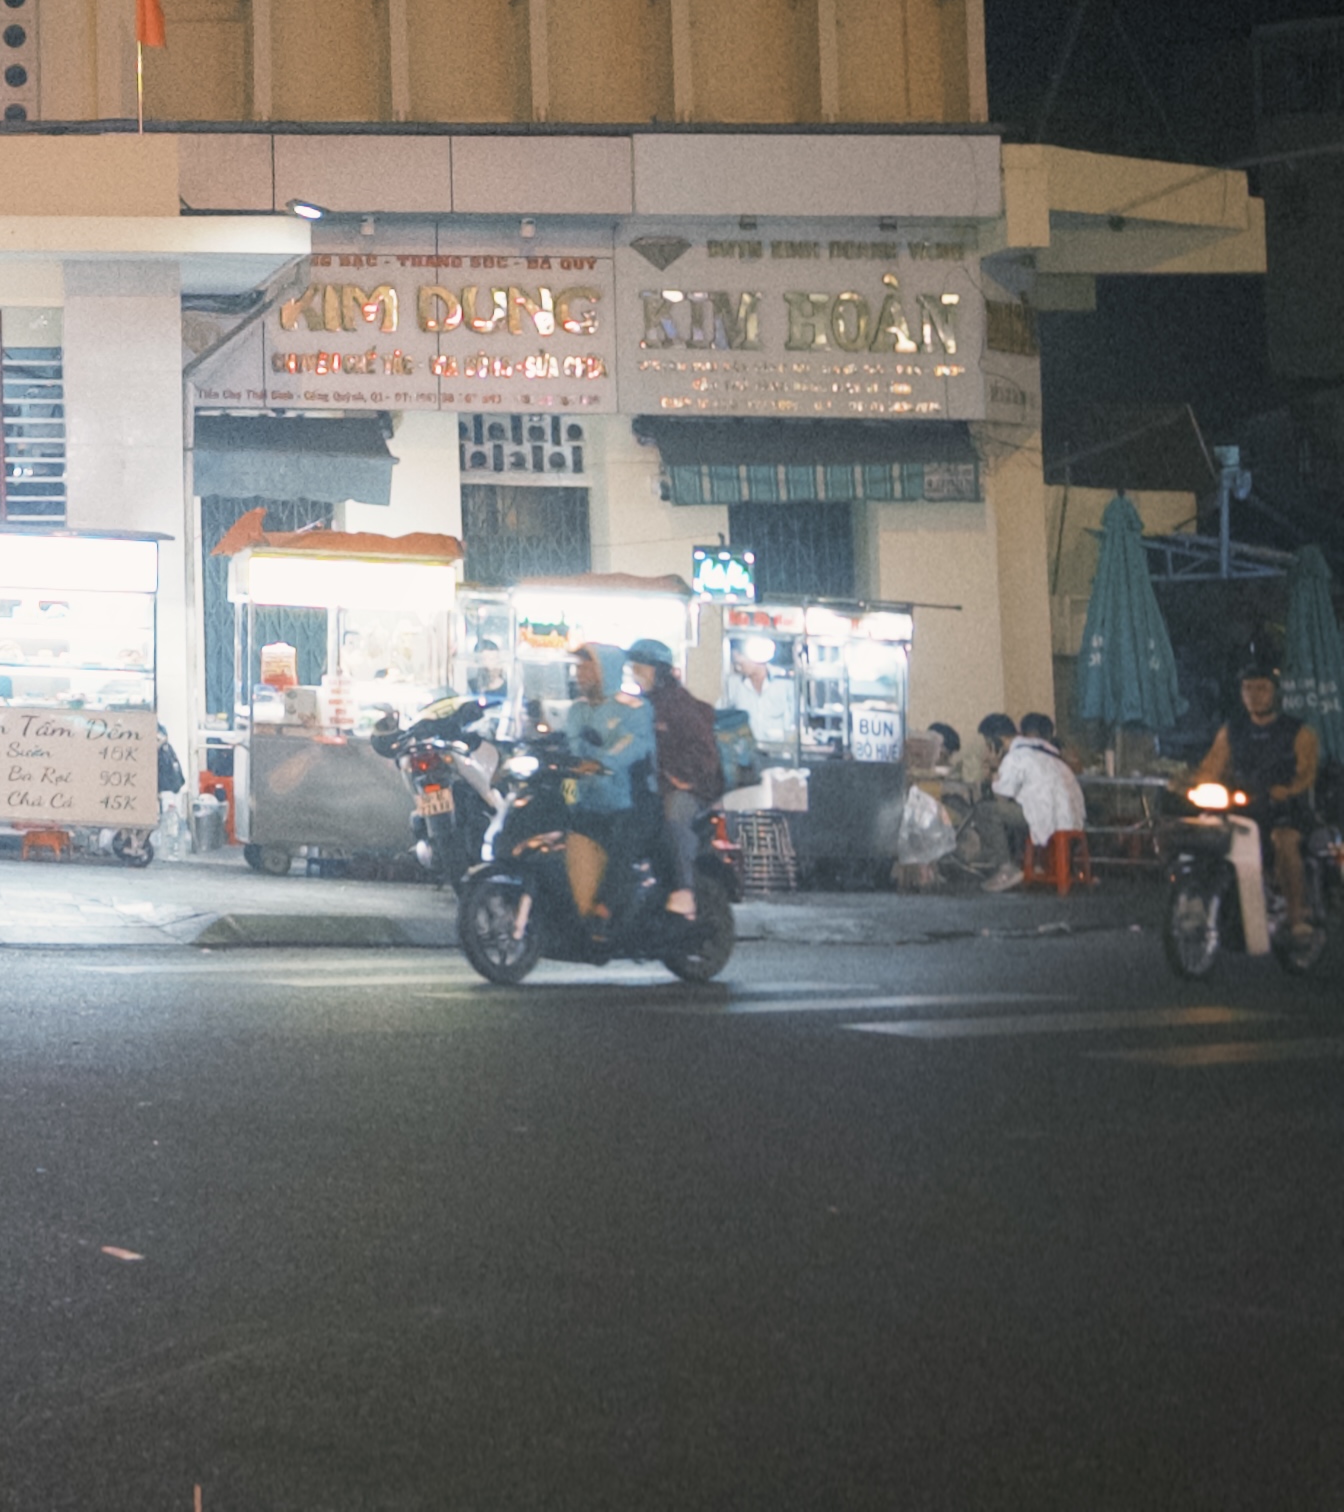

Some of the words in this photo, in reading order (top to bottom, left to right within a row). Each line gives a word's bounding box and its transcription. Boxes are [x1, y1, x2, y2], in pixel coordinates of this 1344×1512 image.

[279, 283, 400, 333] KIM
[416, 283, 605, 336] DUNG
[639, 289, 763, 351] KIM
[783, 273, 961, 355] HOÀN
[21, 715, 74, 737] Tấm
[859, 713, 894, 737] BÚN
